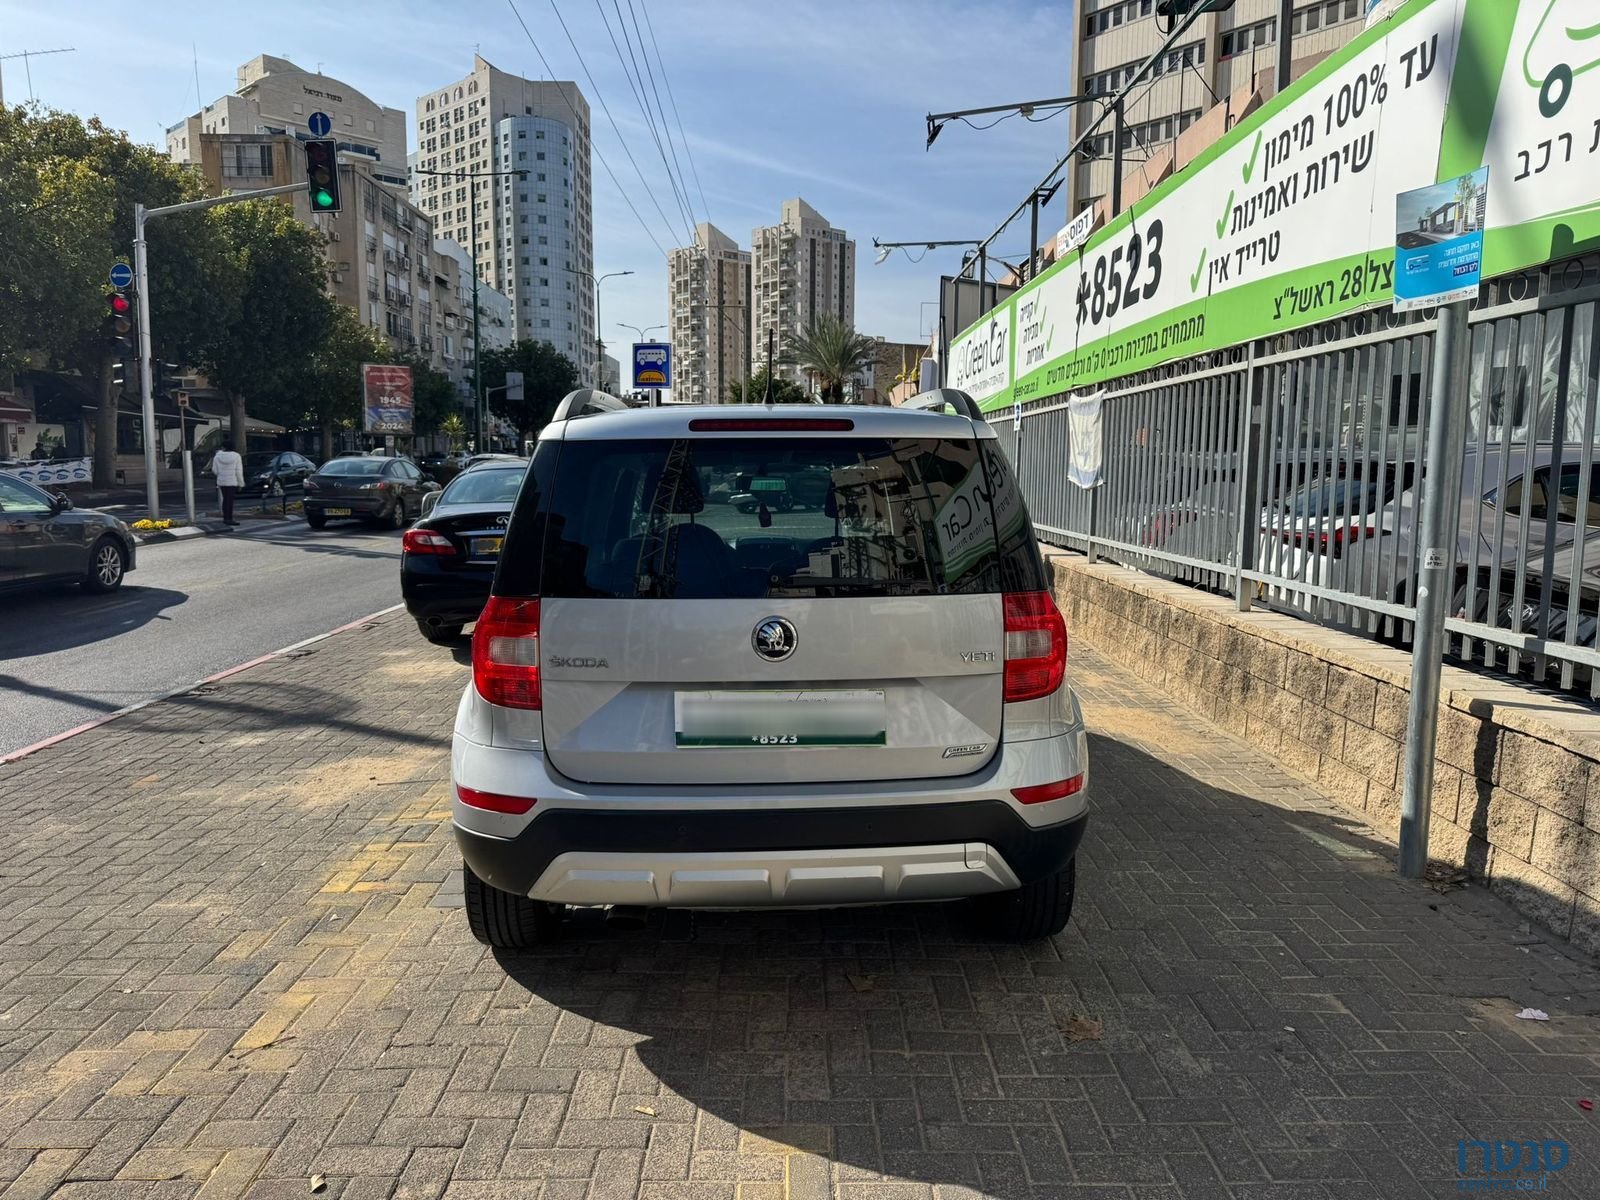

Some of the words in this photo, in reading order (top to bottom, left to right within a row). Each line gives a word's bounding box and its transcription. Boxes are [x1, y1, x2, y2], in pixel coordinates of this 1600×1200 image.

[1400, 33, 1438, 89] עד
[1324, 63, 1388, 136] 100%
[1263, 114, 1315, 182] מימון
[1303, 130, 1374, 200] שירות
[1513, 132, 1573, 182] רכב
[1230, 172, 1299, 236] ואמינות
[1070, 213, 1089, 240] דפוס
[1208, 252, 1231, 296] אין
[1235, 229, 1281, 277] טרייד
[1339, 265, 1363, 301] 28
[1369, 258, 1394, 294] צל
[965, 339, 989, 380] Green
[989, 320, 1008, 367] Car
[1125, 331, 1158, 361] במכירת
[1161, 313, 1205, 349] מתמחים
[1108, 344, 1124, 367] רכבי
[549, 655, 609, 669] ŠKODA
[960, 651, 995, 663] YETI
